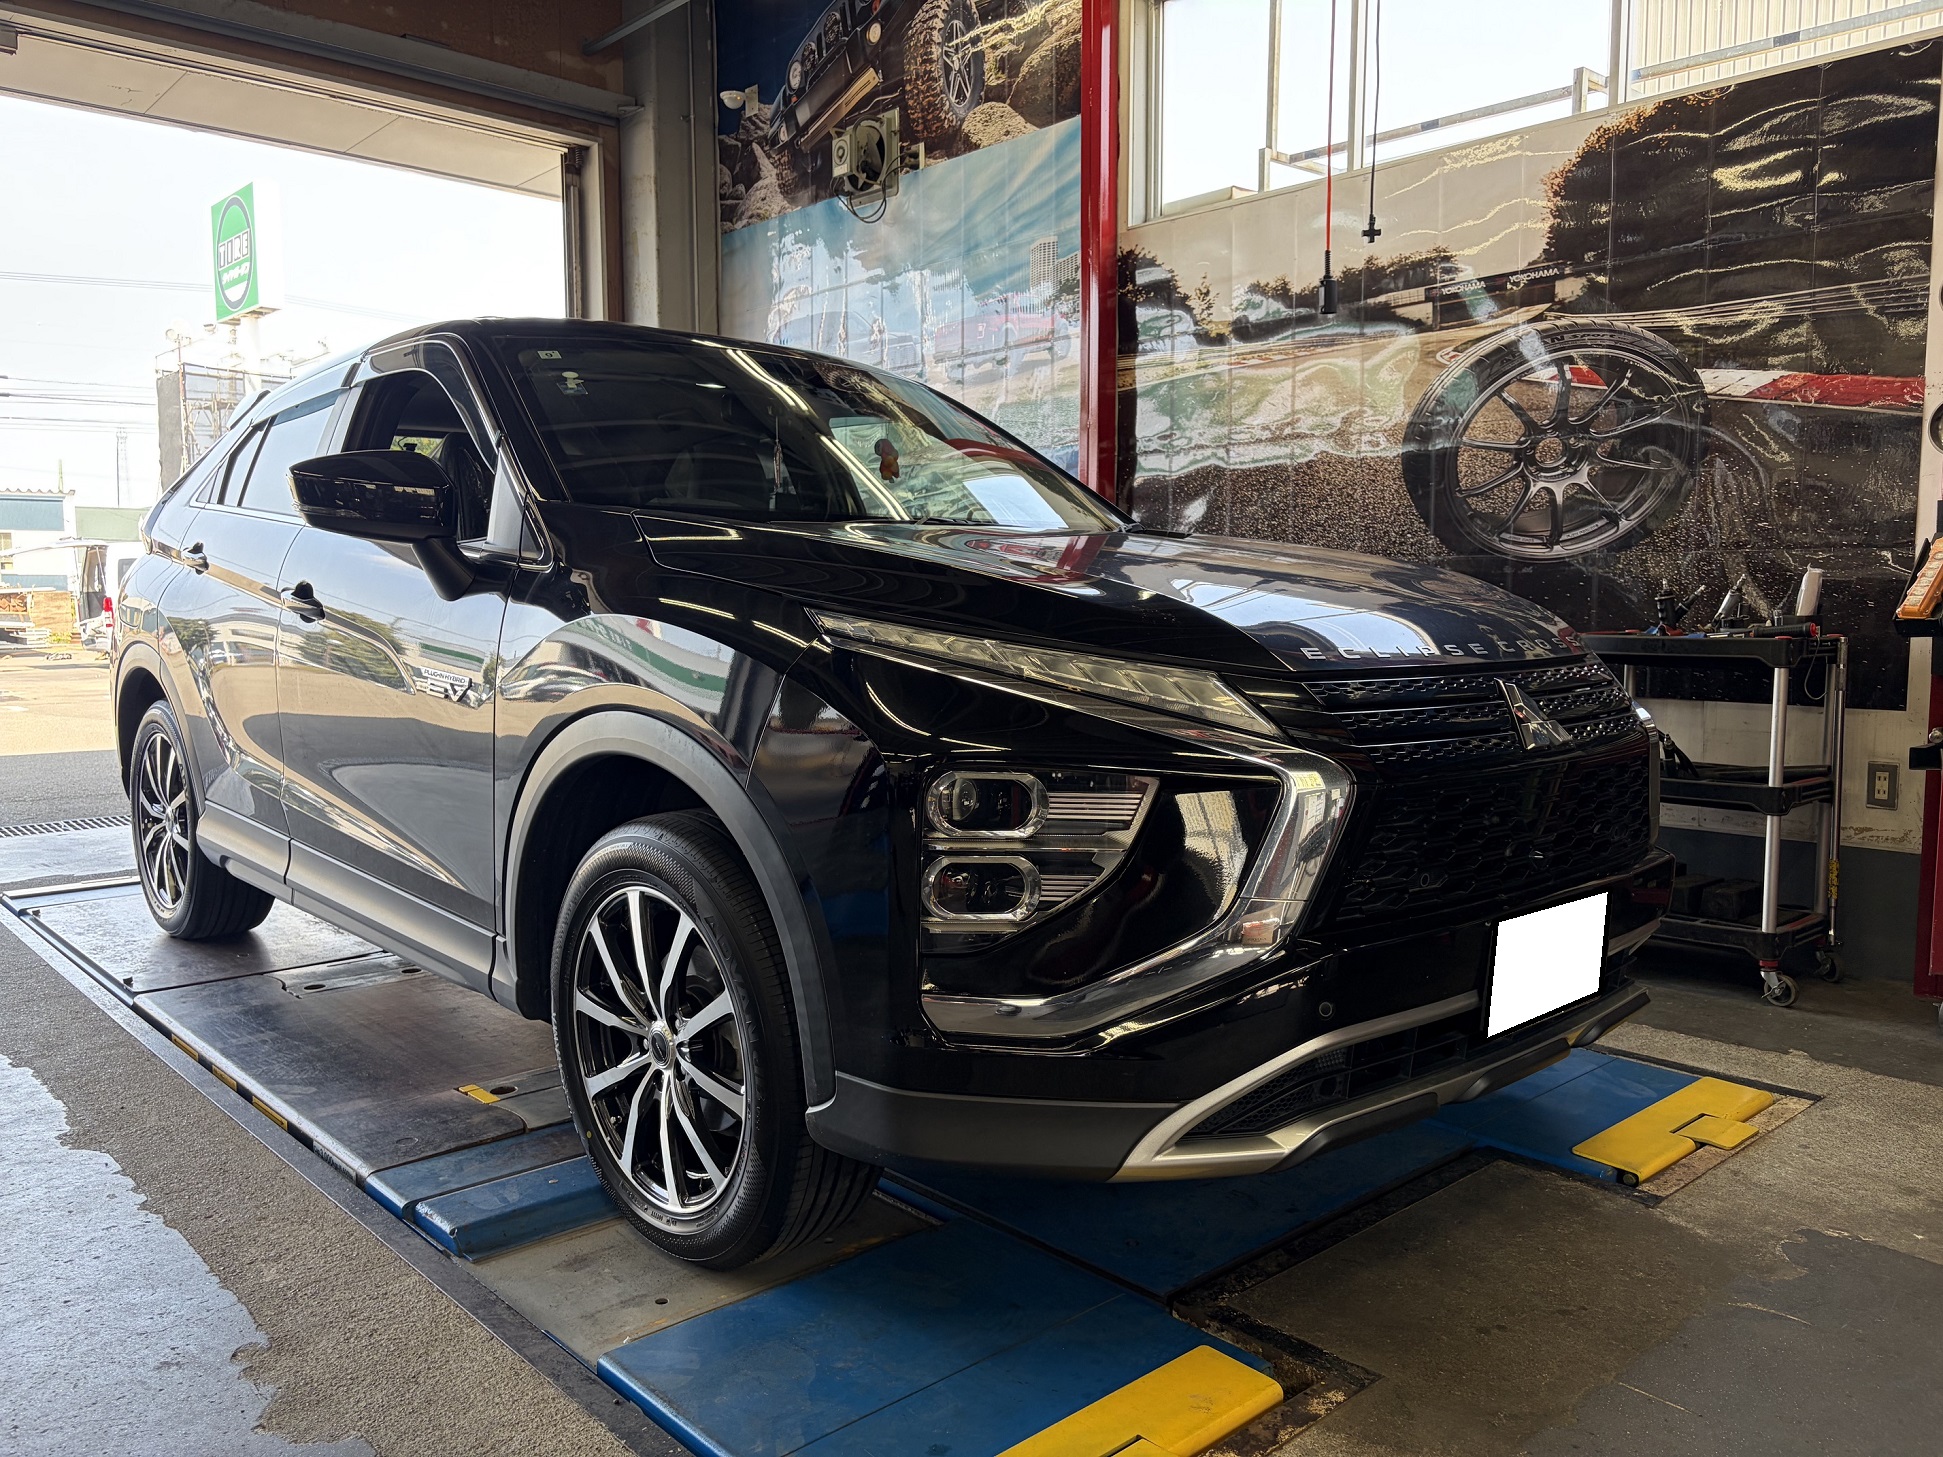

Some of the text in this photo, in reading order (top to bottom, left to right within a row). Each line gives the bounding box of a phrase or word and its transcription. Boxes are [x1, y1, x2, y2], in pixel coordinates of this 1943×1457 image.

[219, 230, 249, 269] TIRE
[1509, 268, 1560, 283] YOKOHAMA
[1441, 281, 1486, 295] YOKOHAMA
[1300, 636, 1581, 660] ECLIPSE CROSS
